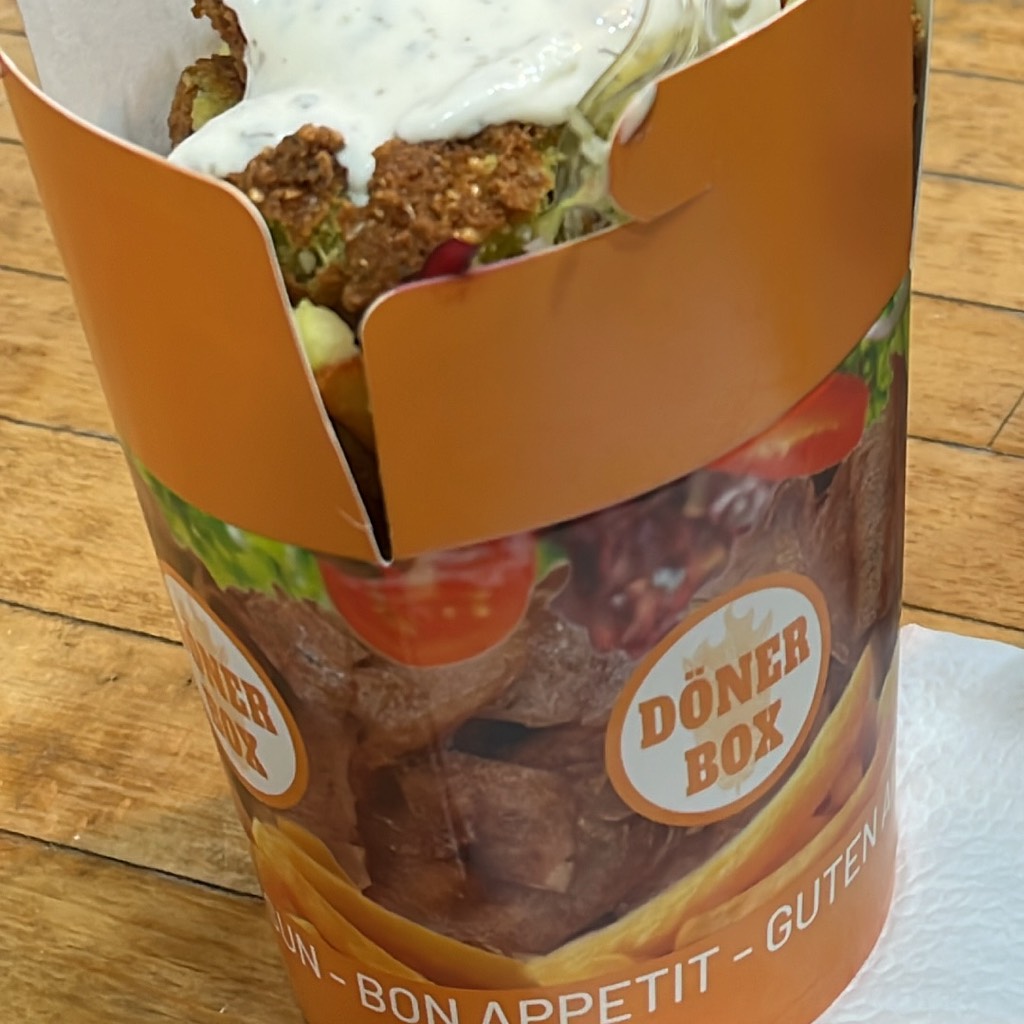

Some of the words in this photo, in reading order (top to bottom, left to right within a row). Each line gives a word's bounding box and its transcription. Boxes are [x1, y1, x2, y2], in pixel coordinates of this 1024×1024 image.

[638, 615, 811, 751] DÖNER
[684, 699, 784, 798] BOX
[356, 971, 460, 1024] BON
[481, 946, 721, 1024] APPETIT
[765, 805, 878, 954] GUTEN
